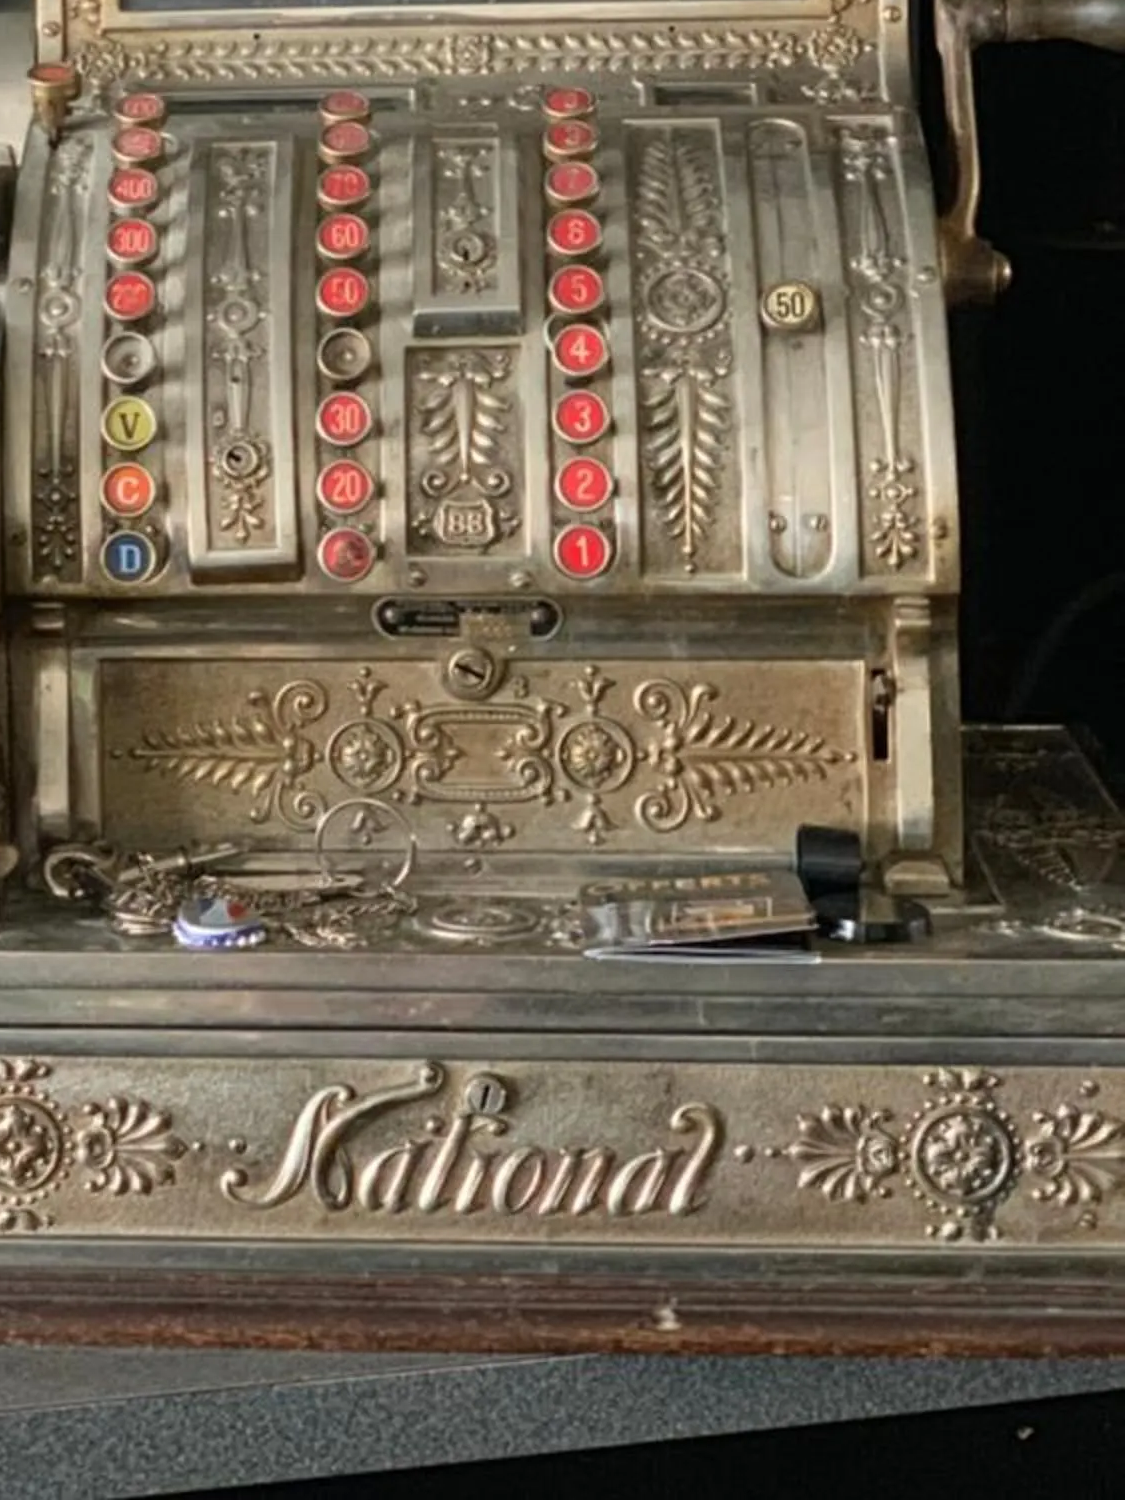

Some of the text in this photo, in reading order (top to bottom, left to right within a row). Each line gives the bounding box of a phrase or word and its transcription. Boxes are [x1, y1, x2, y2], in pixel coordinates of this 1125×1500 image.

[113, 226, 150, 253] 300
[331, 222, 360, 249] 60
[570, 280, 588, 303] 5
[775, 292, 806, 319] 50
[569, 338, 589, 363] 4
[117, 411, 140, 441] V
[331, 403, 361, 435] 30
[573, 405, 591, 432] 3
[116, 475, 141, 503] C
[332, 470, 363, 501] 20
[576, 469, 595, 499] 2
[118, 544, 143, 574] D
[576, 535, 591, 568] 1
[221, 1059, 725, 1216] National
